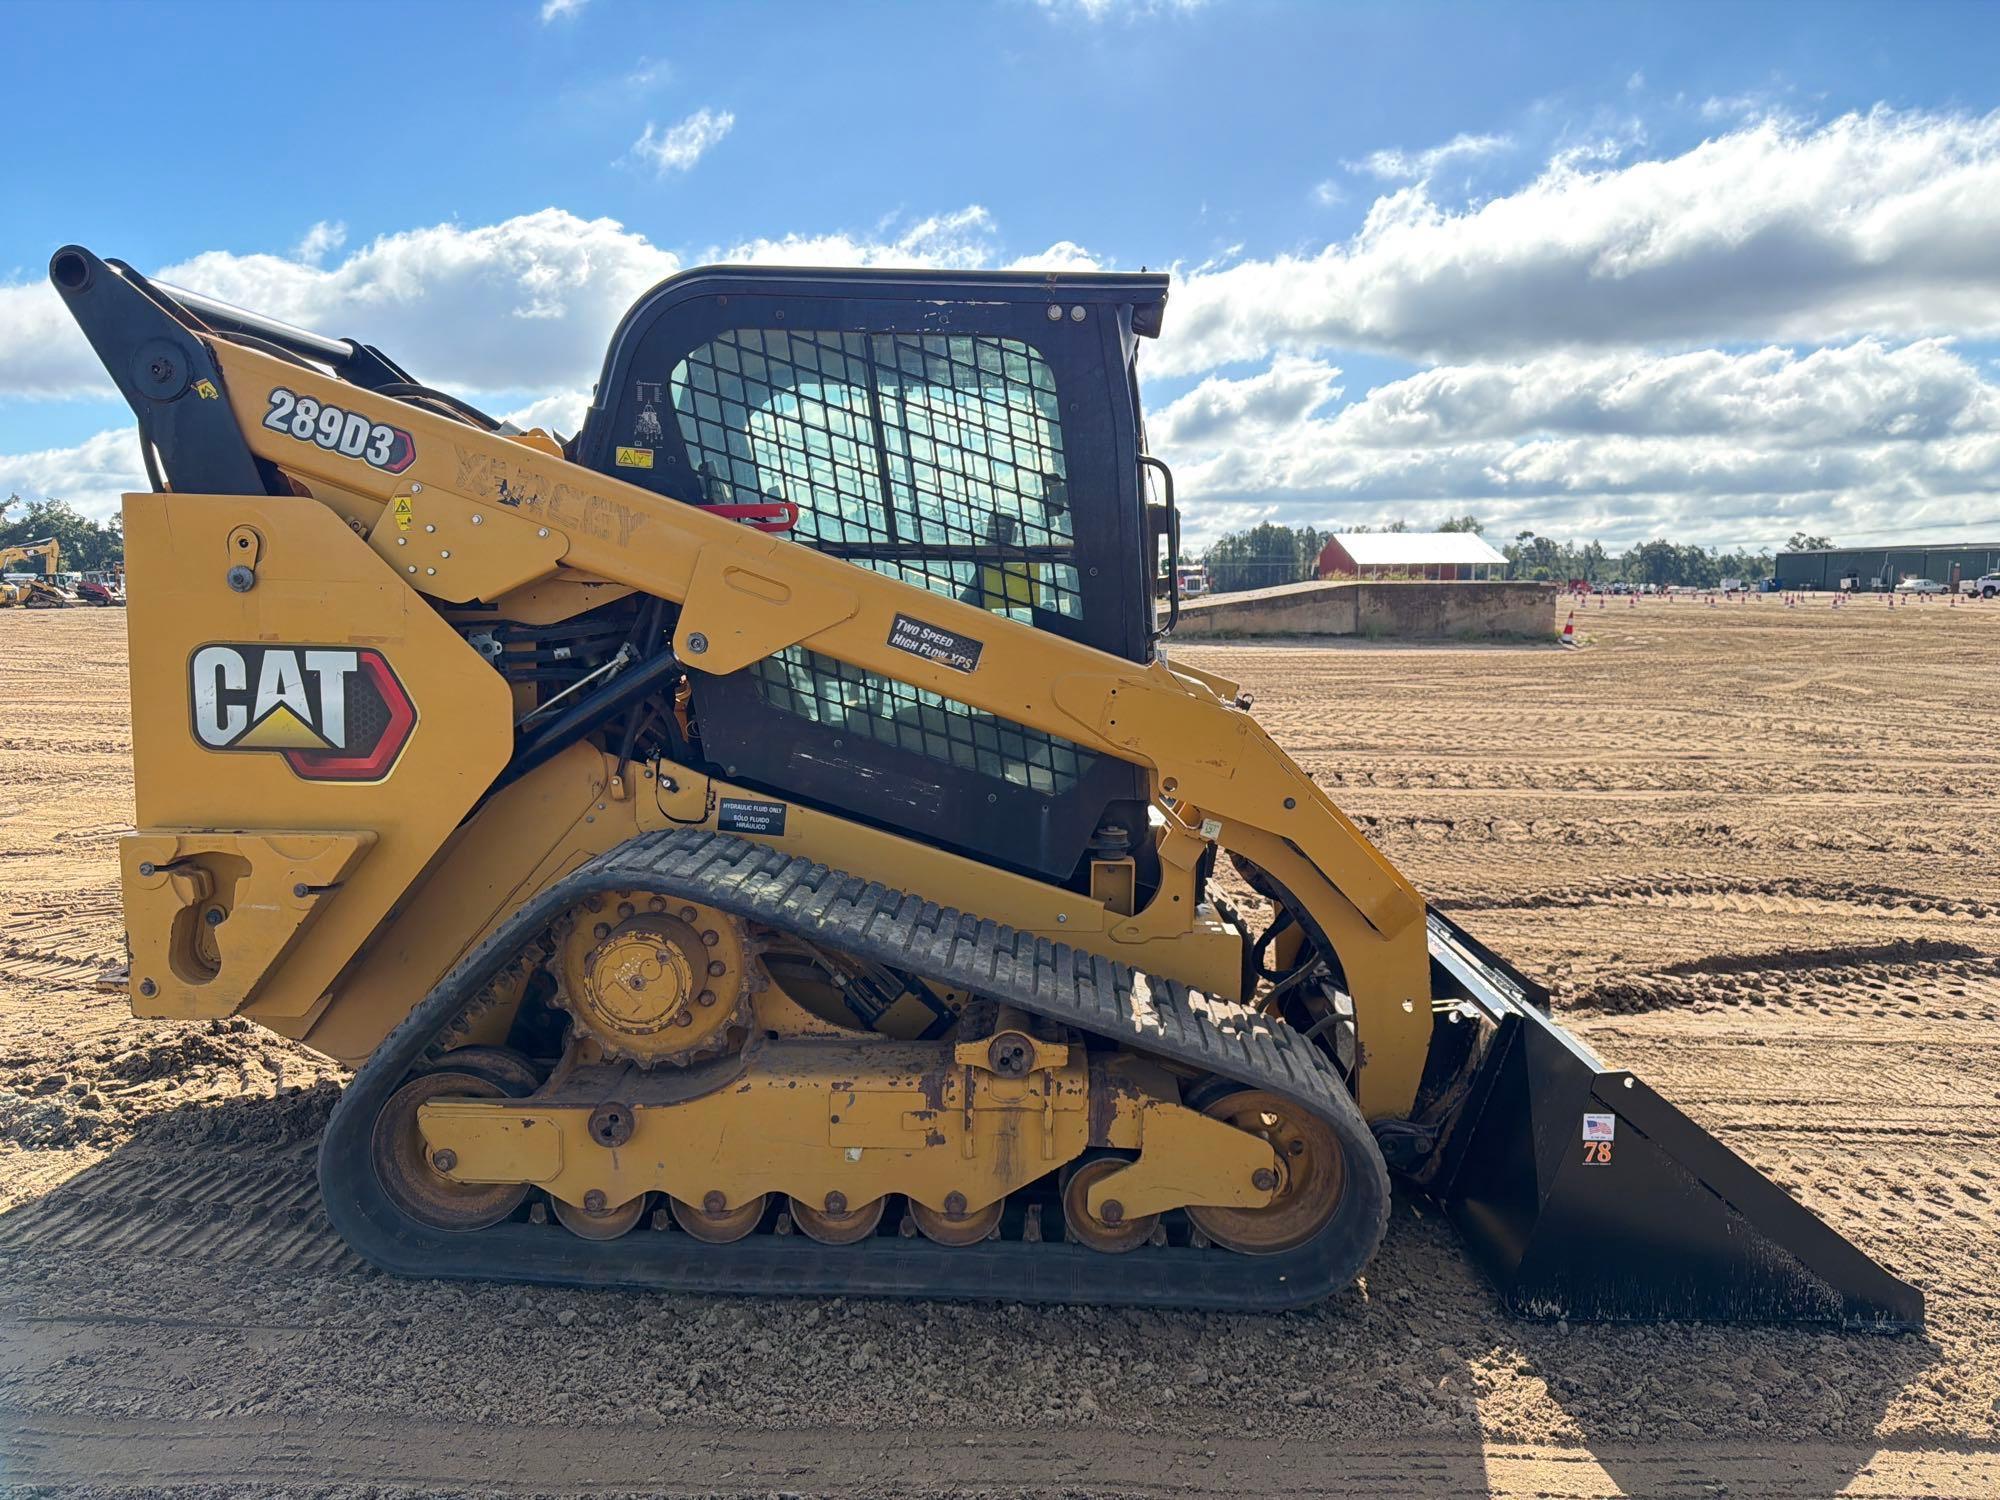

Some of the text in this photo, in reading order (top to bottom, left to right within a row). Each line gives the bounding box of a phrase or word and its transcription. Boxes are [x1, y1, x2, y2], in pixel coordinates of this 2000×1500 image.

[264, 388, 395, 466] 289D3
[892, 633, 919, 651] HIGH
[919, 643, 949, 659] FLOW
[896, 619, 954, 648] TWO SPEED
[193, 646, 358, 749] CAT
[723, 803, 752, 811] HYDRAULIC
[1583, 1141, 1612, 1163] 78
